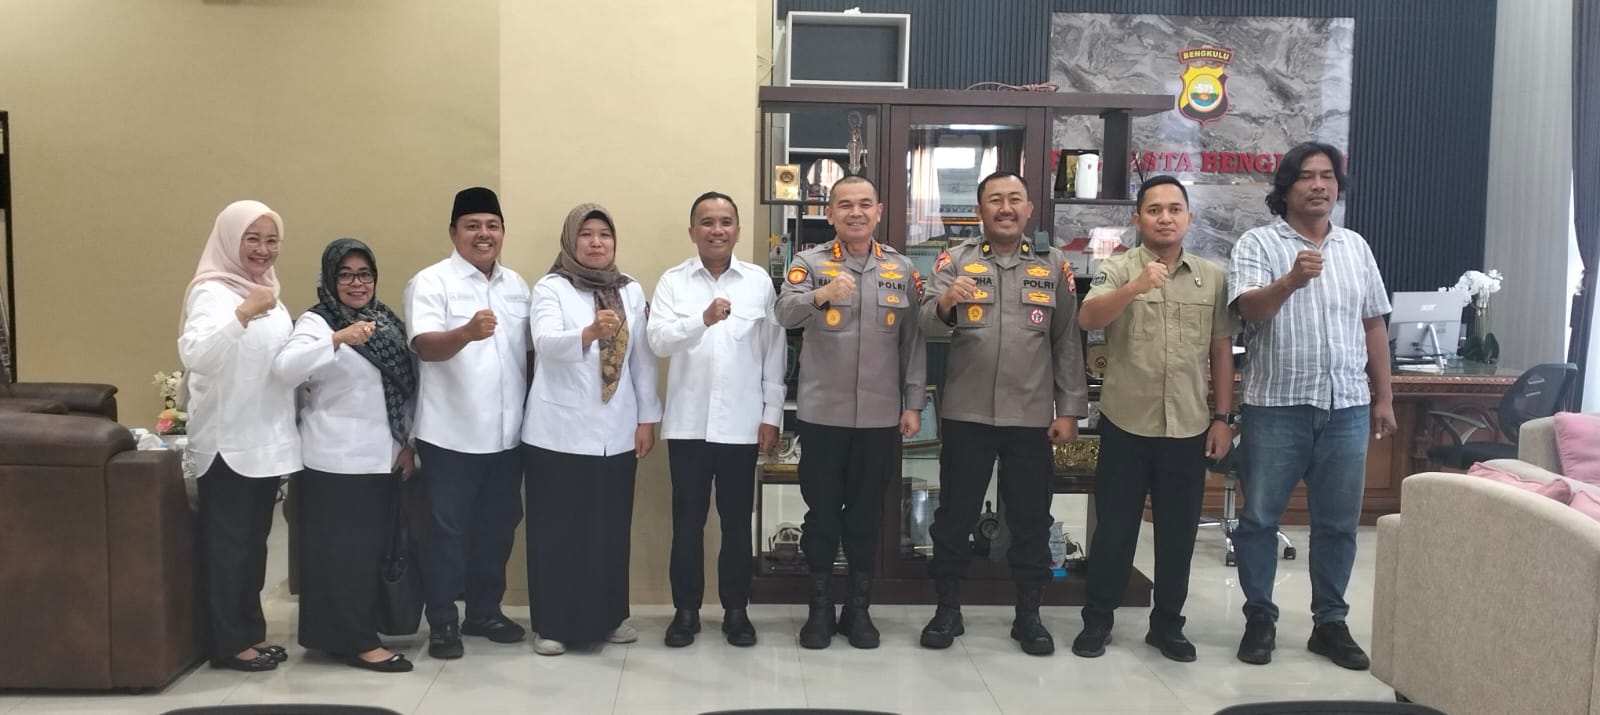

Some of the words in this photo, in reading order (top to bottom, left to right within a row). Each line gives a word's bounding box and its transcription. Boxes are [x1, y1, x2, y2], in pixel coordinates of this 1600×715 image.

[1183, 50, 1230, 60] BENGKULU
[878, 280, 906, 292] POLRI
[1023, 279, 1055, 290] POLRI
